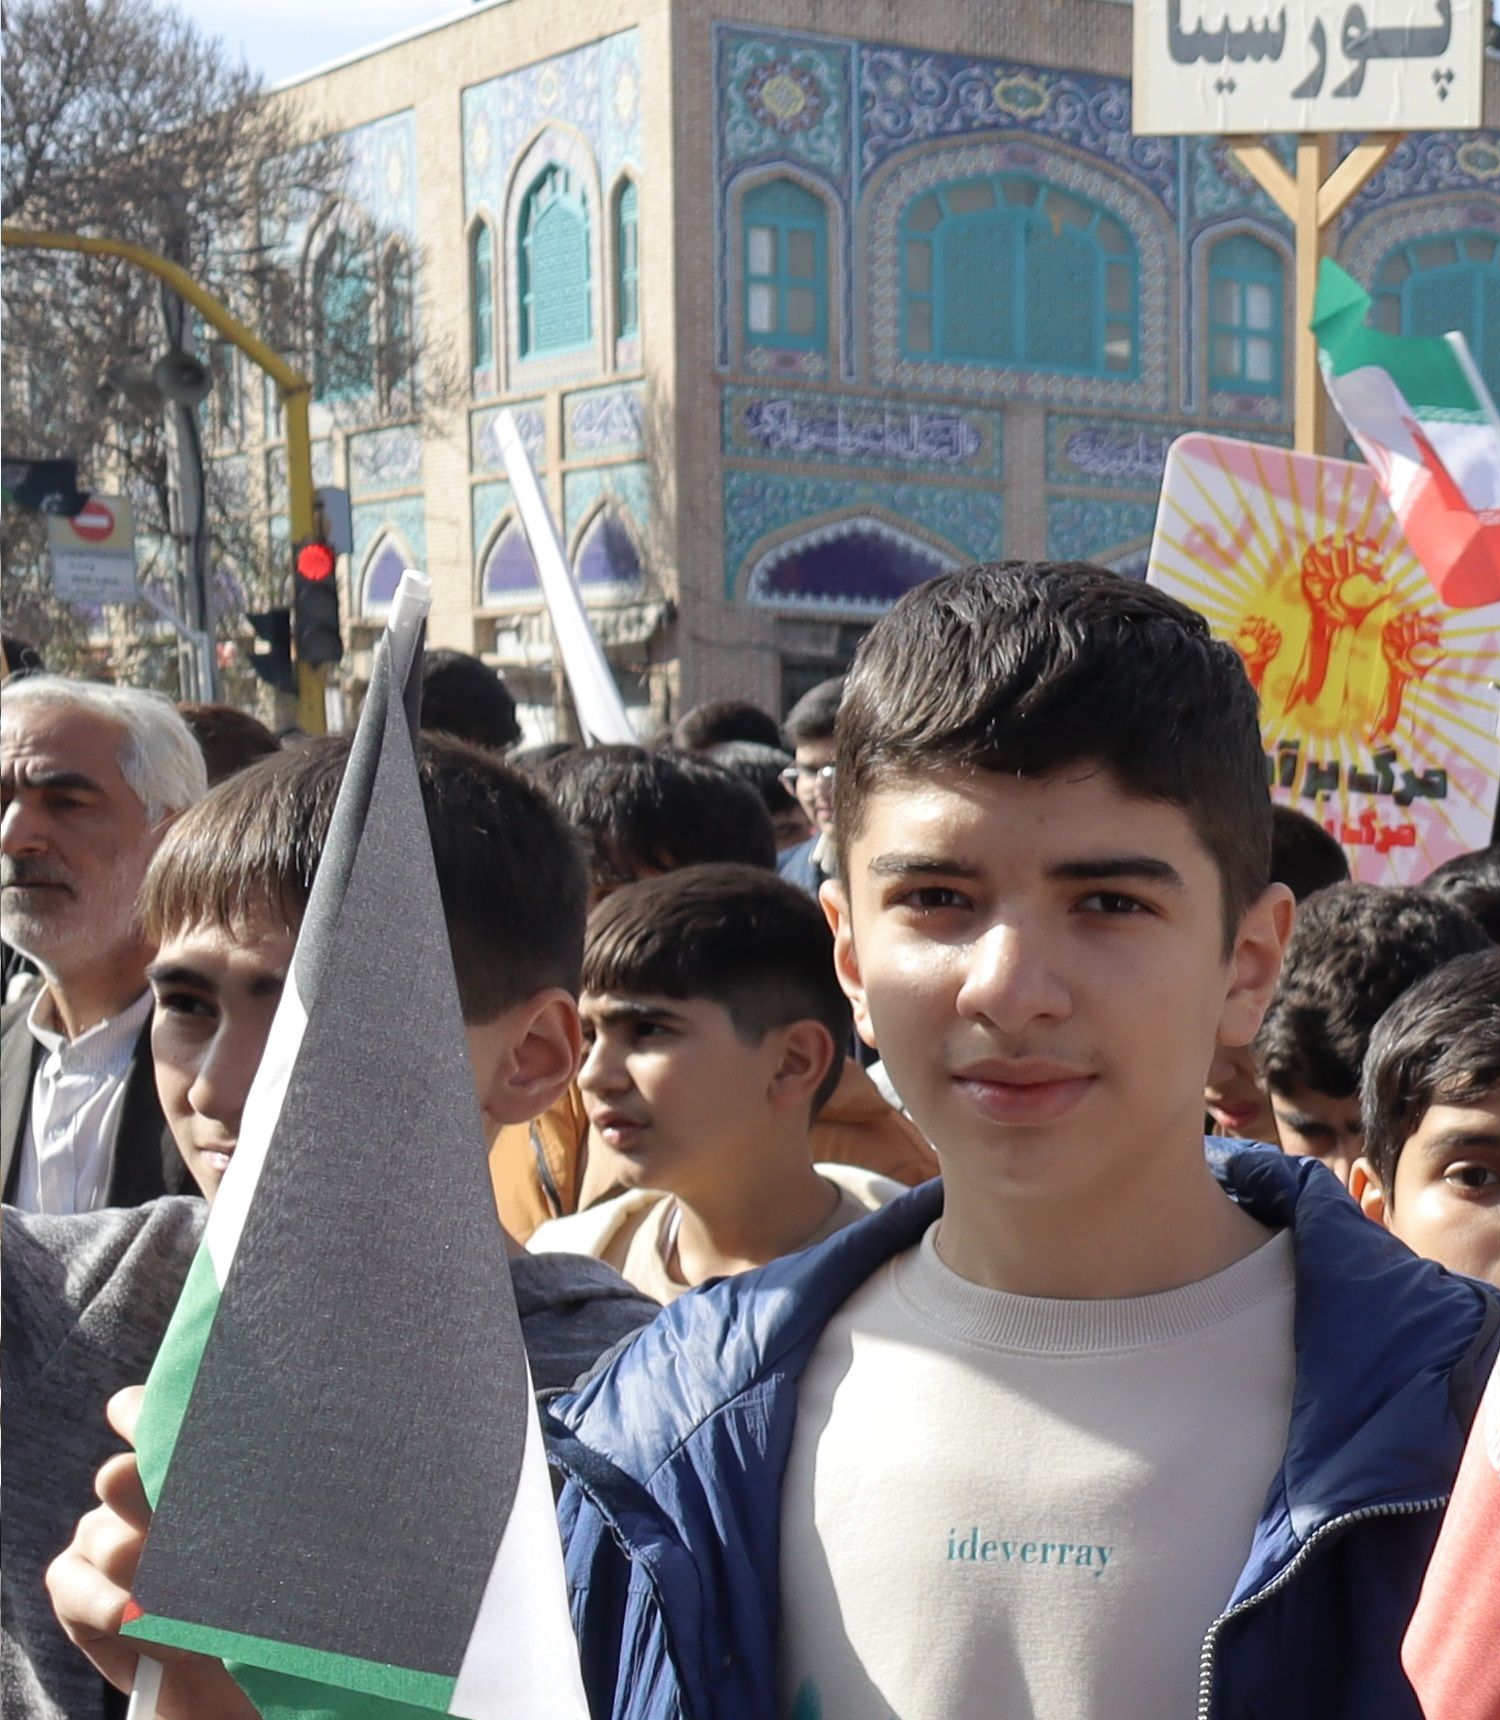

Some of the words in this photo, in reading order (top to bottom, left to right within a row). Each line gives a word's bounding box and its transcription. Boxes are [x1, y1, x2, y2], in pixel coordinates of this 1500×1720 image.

[1348, 745, 1448, 806] مرگ
[1341, 808, 1416, 853] مرگ
[946, 1527, 1115, 1577] ideverray
